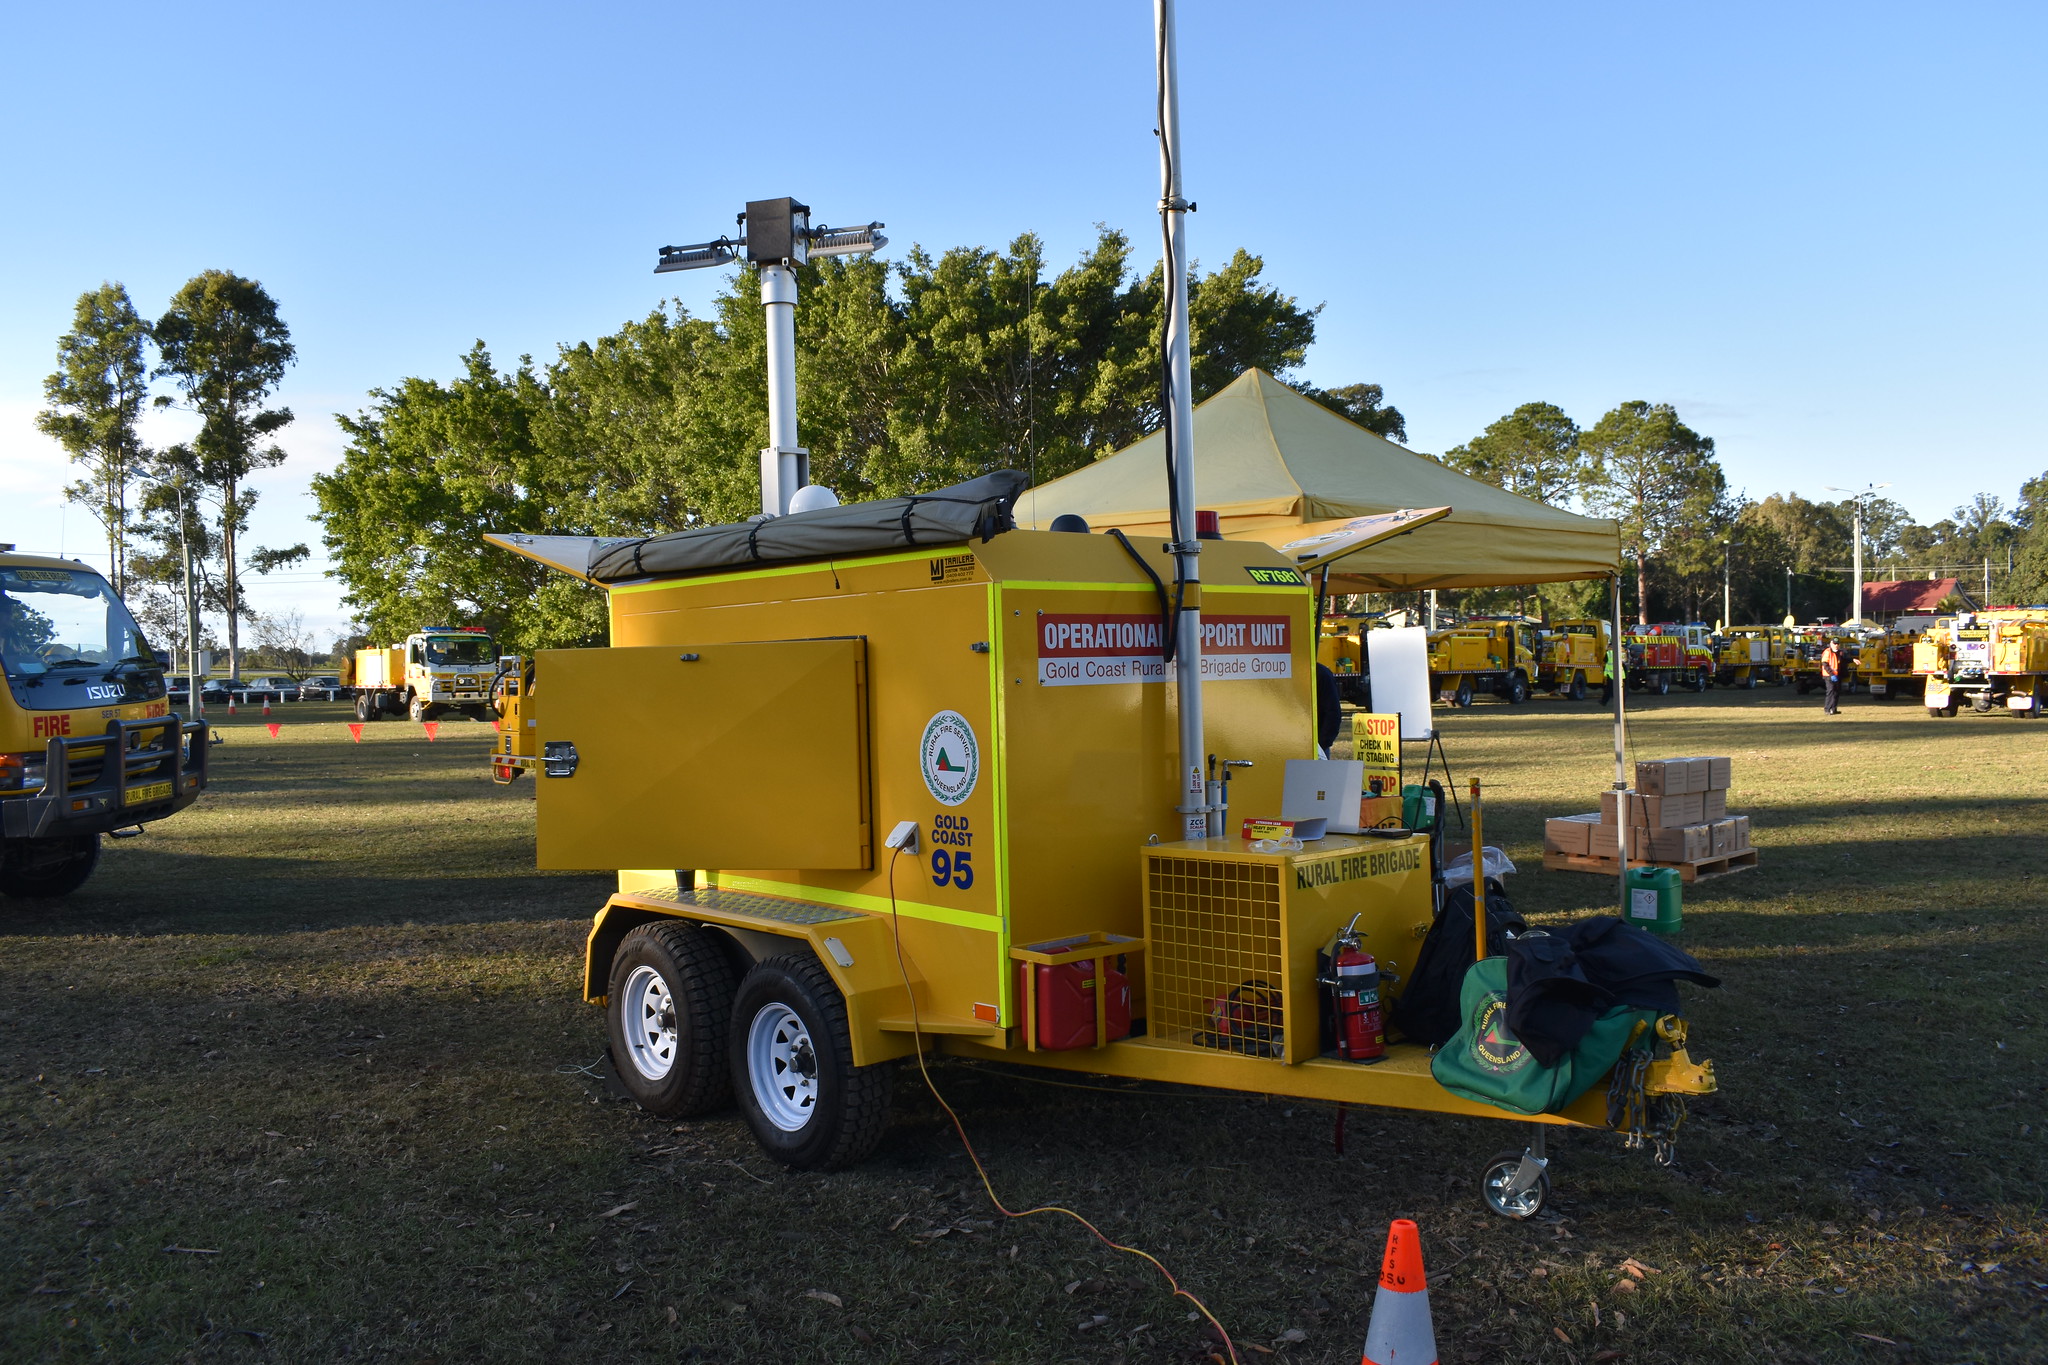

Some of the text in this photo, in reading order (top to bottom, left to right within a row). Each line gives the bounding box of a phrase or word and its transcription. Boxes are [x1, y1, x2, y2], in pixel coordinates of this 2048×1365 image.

[945, 554, 974, 565] TRAILERS
[1249, 569, 1302, 584] RF7681
[1199, 622, 1246, 648] PPORT
[1251, 623, 1285, 646] UNIT
[1046, 661, 1079, 679] Gold
[1086, 661, 1126, 678] Coast
[1132, 660, 1166, 676] Rural
[1201, 658, 1246, 676] Brigade
[1251, 658, 1286, 675] Group
[87, 683, 126, 700] ISUZU
[33, 714, 71, 738] FIRE
[1367, 718, 1396, 736] STOP
[929, 725, 971, 759] RURAL FIRE SERVICE
[1360, 739, 1391, 750] CHECK IN
[1357, 752, 1394, 763] AT STAGING
[933, 774, 967, 794] QUEENSLAND
[935, 815, 969, 830] GOLD
[932, 830, 973, 846] COAST
[932, 848, 974, 890] 95
[1297, 848, 1420, 889] RURAL FIRE BRIGADE
[1481, 1007, 1494, 1029] RURAL
[1478, 1044, 1520, 1064] QUEENSLAND
